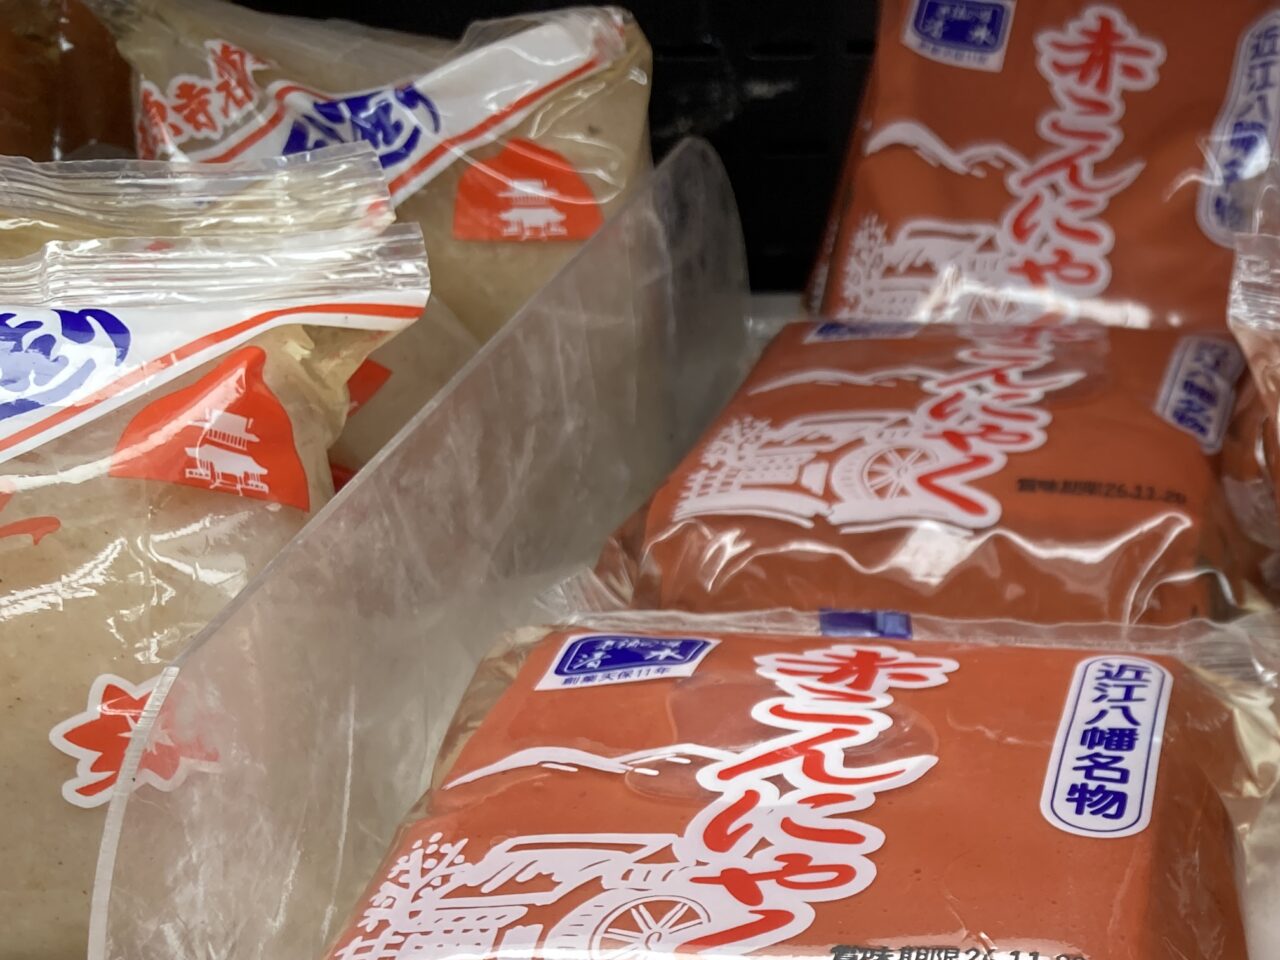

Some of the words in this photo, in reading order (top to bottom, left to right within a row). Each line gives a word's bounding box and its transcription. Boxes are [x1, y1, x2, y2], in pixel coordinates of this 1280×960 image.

[1008, 16, 1155, 322] 赤こんにゃ
[1065, 662, 1153, 821] 近江八幡名物
